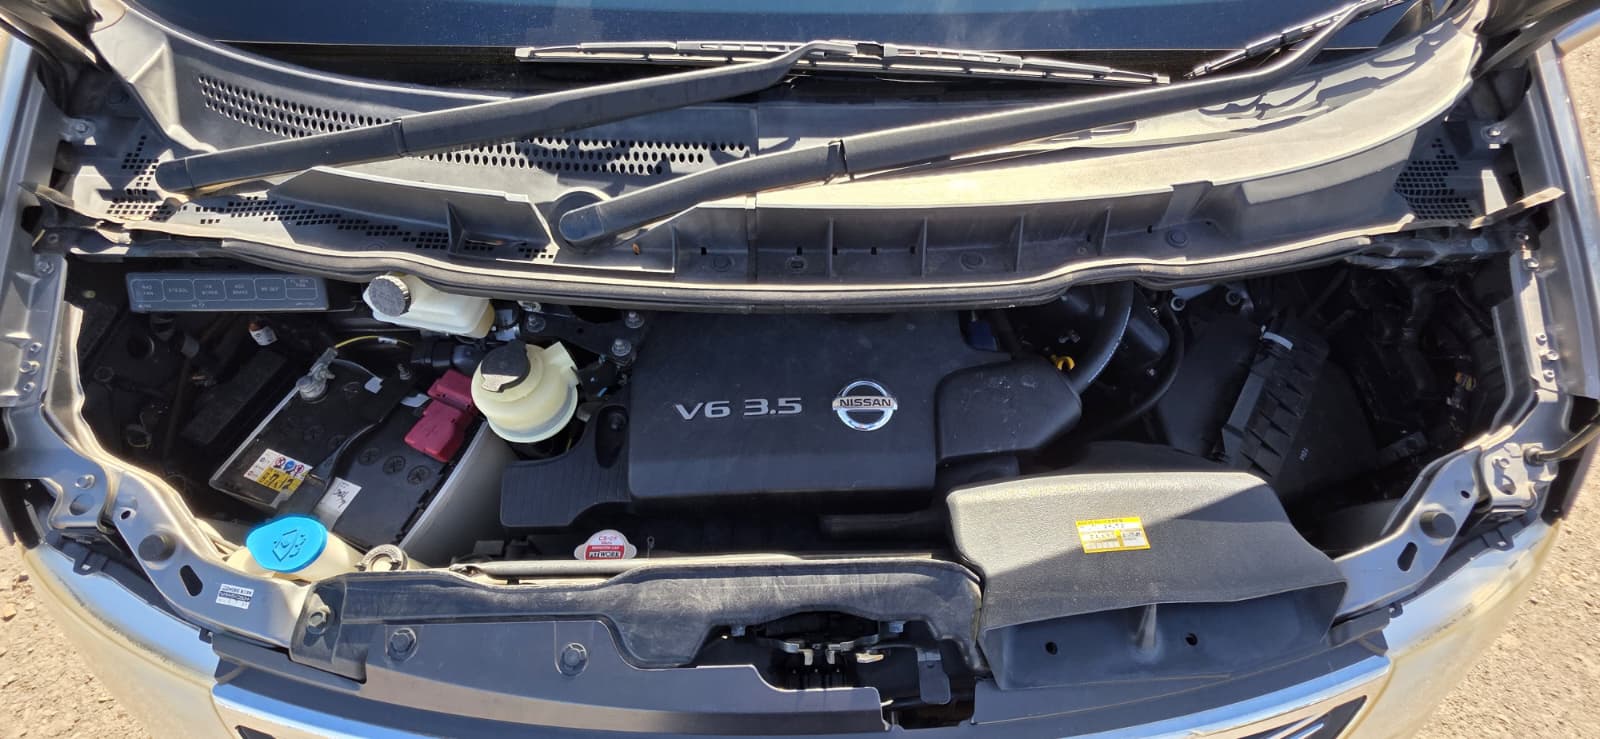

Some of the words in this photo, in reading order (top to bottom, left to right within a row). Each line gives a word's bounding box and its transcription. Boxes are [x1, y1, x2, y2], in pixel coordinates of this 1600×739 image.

[675, 400, 731, 420] V6
[743, 397, 803, 417] 3.5
[838, 397, 893, 408] NISSAN
